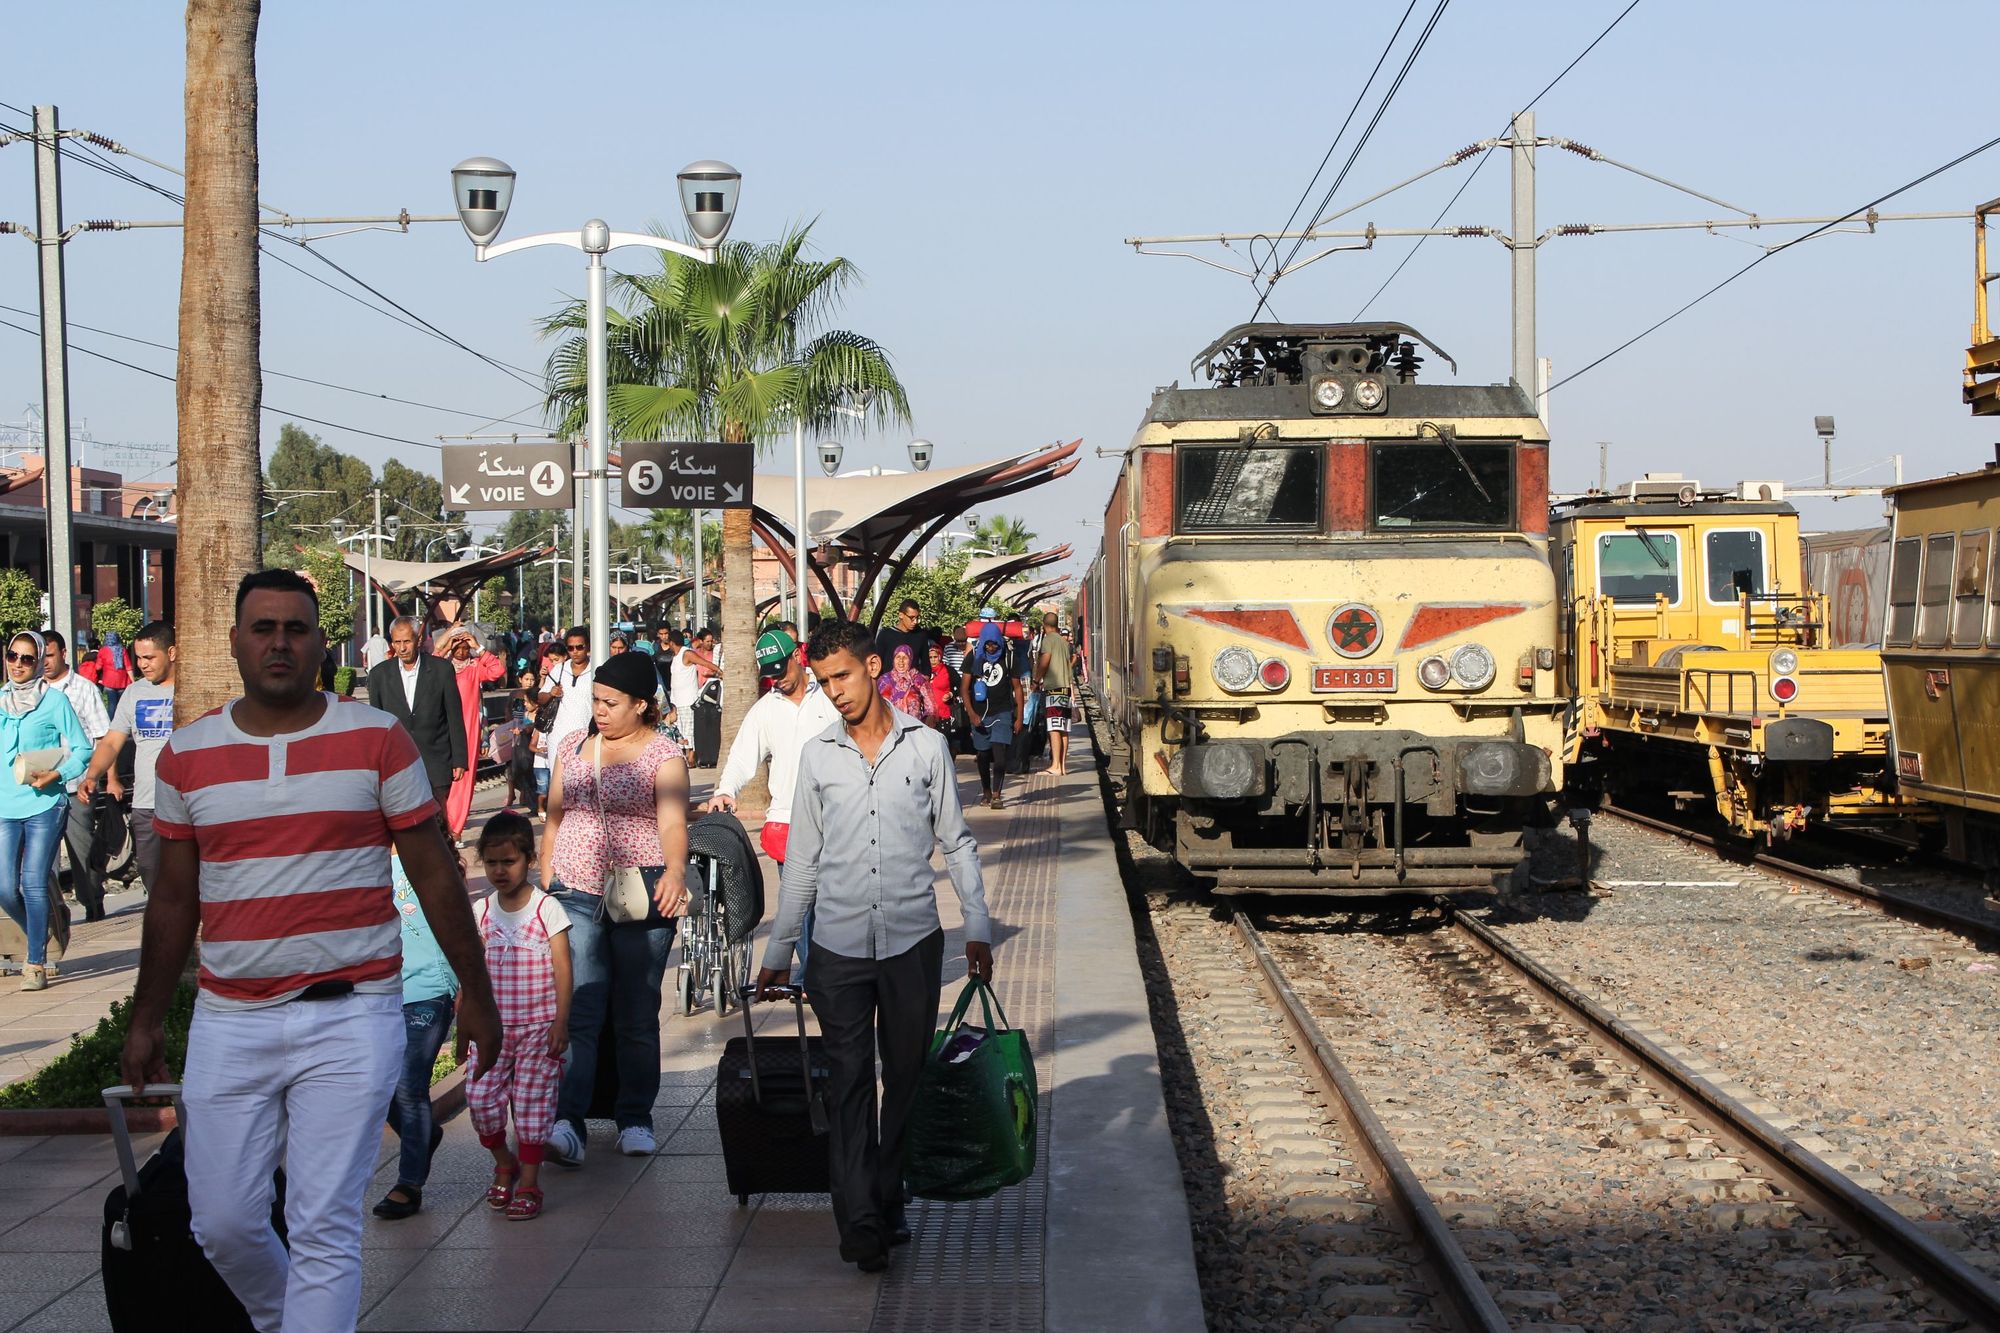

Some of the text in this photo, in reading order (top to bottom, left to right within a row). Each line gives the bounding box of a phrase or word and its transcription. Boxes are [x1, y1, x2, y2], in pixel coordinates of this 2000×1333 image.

[478, 450, 525, 476] سكة
[668, 449, 716, 475] سكة
[537, 465, 554, 490] 4
[638, 465, 655, 490] 5
[480, 486, 525, 501] VOIE
[670, 485, 715, 501] VOIE
[1323, 672, 1386, 685] E-1305
